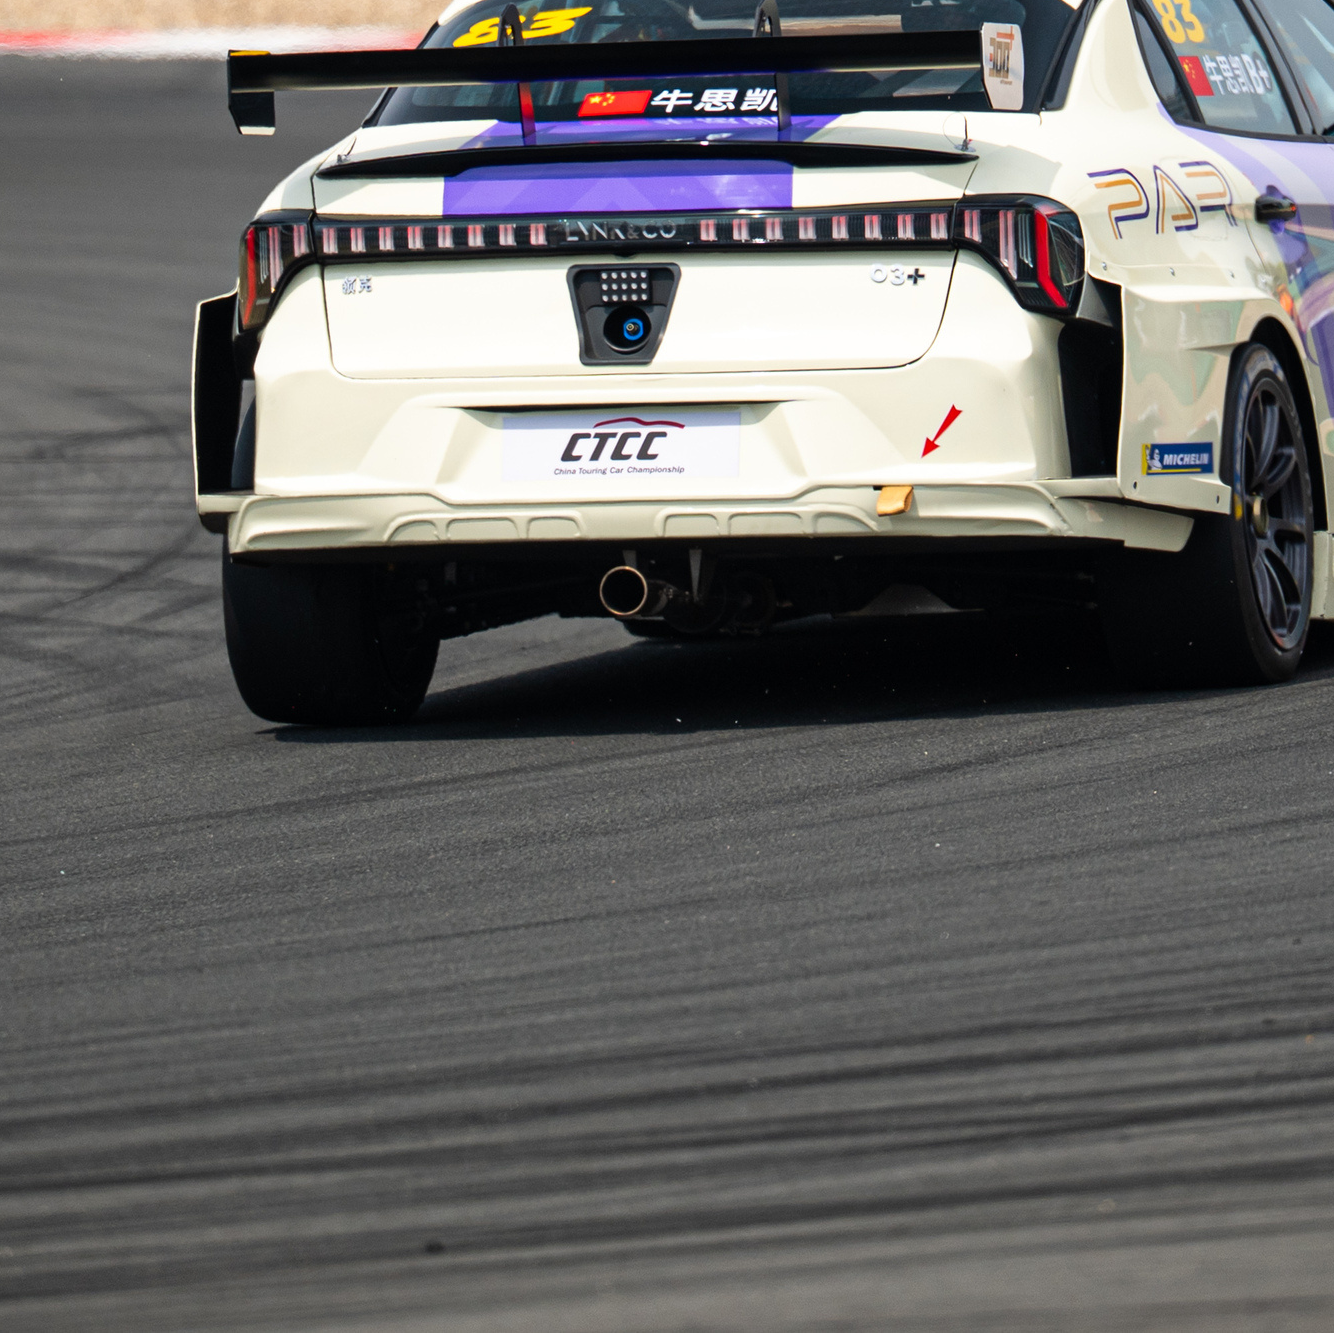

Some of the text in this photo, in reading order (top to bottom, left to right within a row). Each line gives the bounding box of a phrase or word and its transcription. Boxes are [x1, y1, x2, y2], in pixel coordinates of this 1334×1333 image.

[453, 6, 593, 48] 83
[650, 87, 779, 114] 牛思凯
[560, 431, 668, 462] CTCC
[1163, 452, 1209, 466] MICHELIN
[553, 466, 685, 475] China Touring Car Championship
